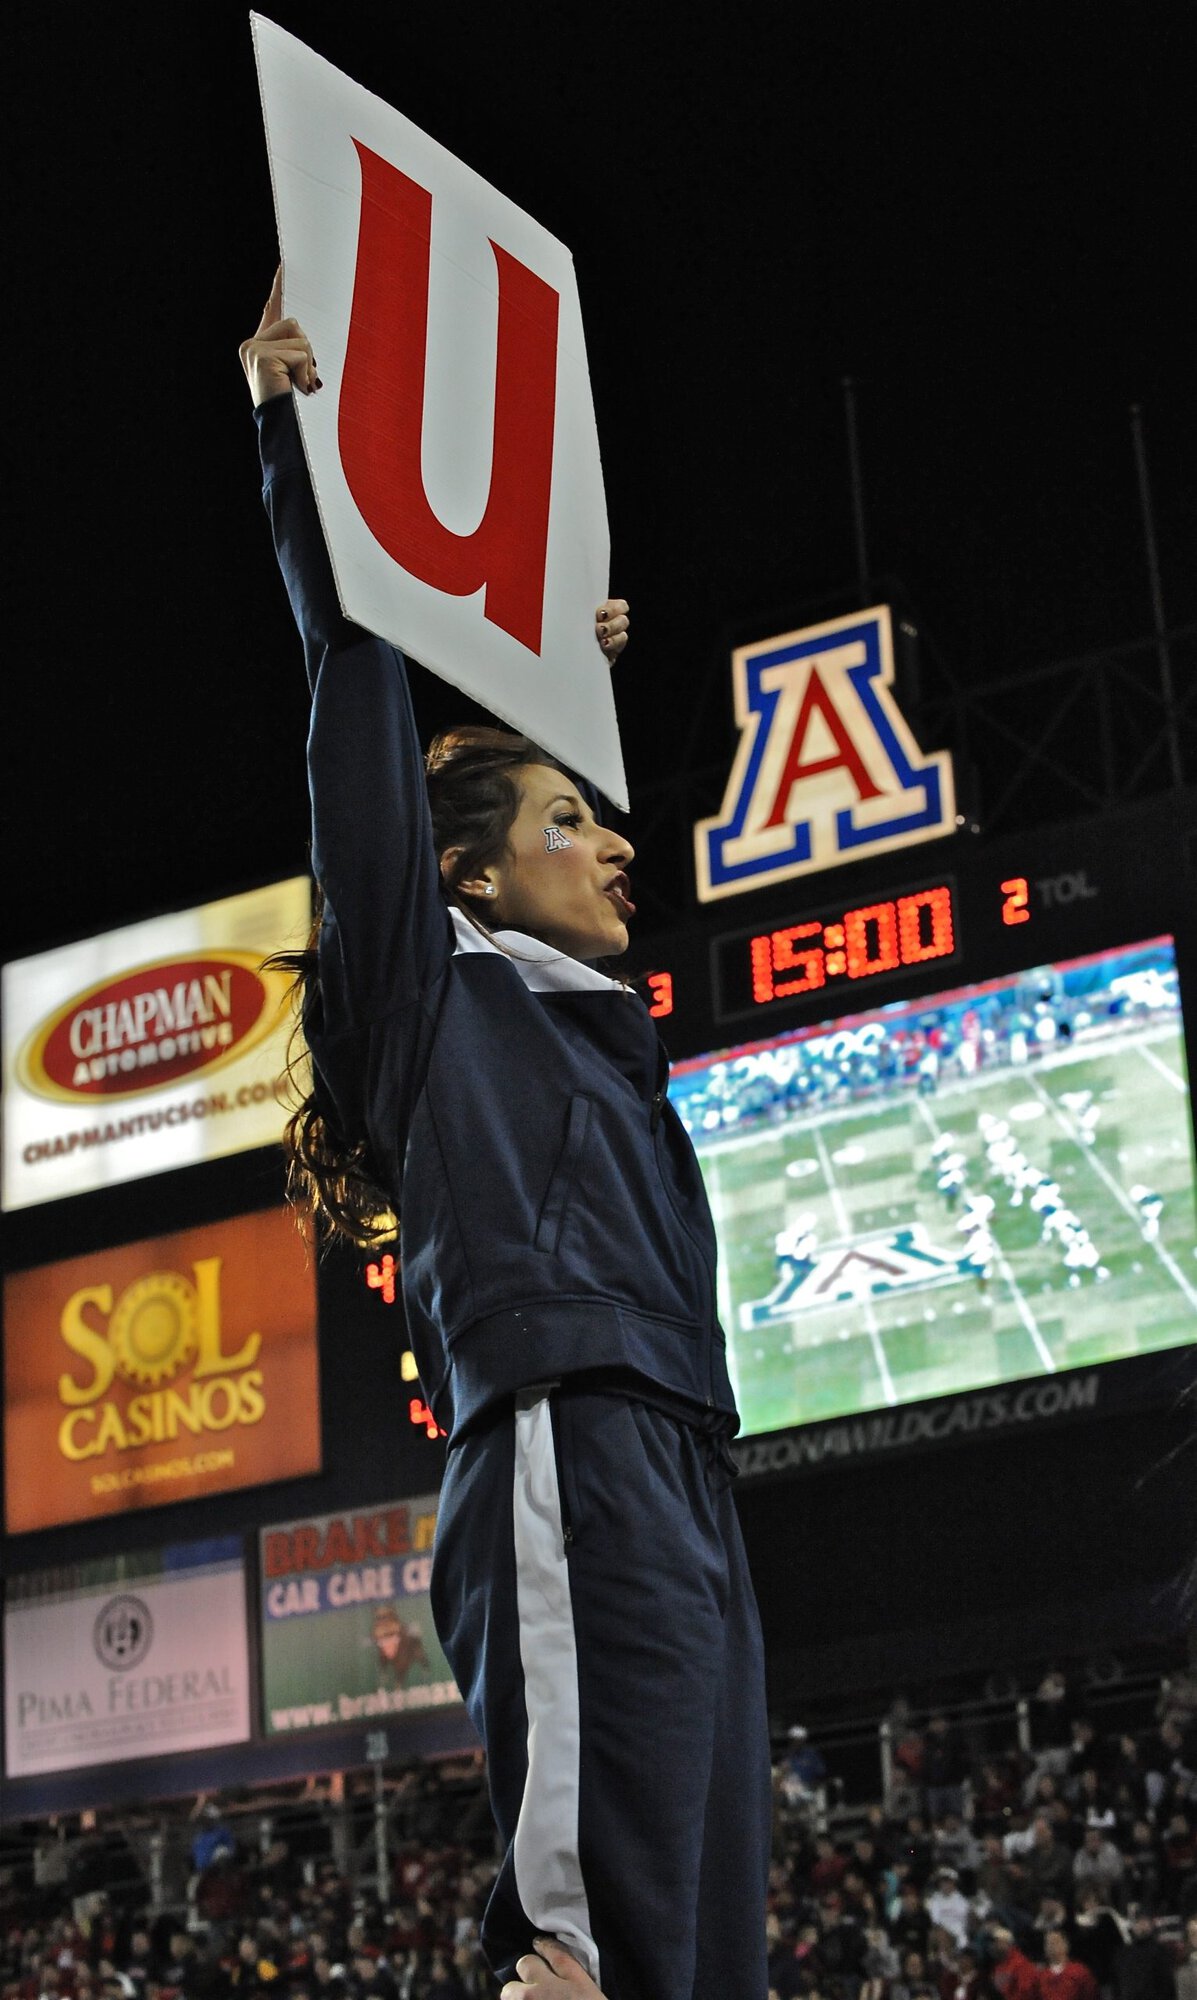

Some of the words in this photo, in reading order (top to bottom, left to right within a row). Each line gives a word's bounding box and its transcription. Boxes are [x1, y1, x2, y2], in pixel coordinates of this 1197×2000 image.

[694, 603, 957, 904] A
[543, 825, 574, 853] A
[1001, 878, 1030, 926] 2
[1040, 870, 1099, 909] TOL
[751, 886, 955, 1004] 15:00
[69, 970, 233, 1060] CHAPMAN
[648, 972, 673, 1019] 3
[72, 1022, 234, 1086] AUTOMOTIVE
[22, 1078, 290, 1165] CHAPMANTUCSON.COM
[366, 1254, 396, 1304] 4
[58, 1256, 262, 1407] SOL
[58, 1370, 266, 1461] CASINOS
[268, 1578, 321, 1618] CAR
[326, 1564, 397, 1607] CARE
[17, 1690, 94, 1728] PIMA
[106, 1665, 236, 1713] FEDERAL
